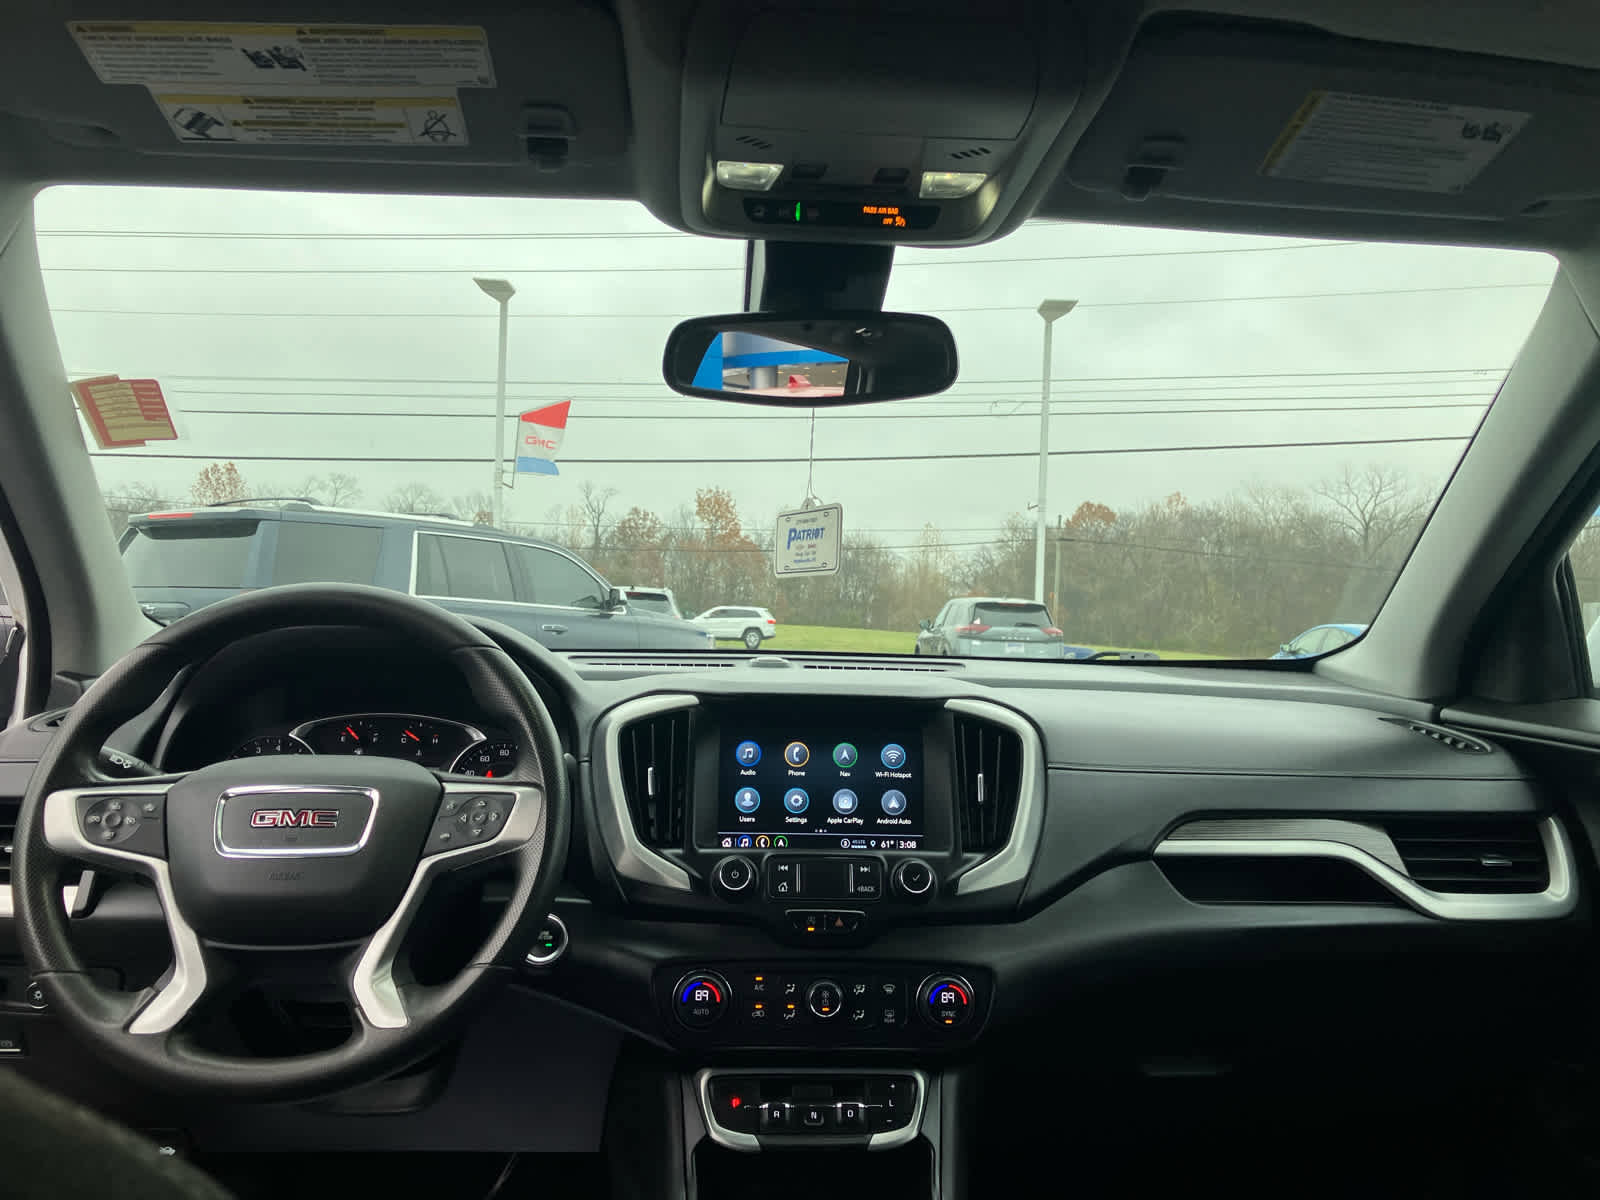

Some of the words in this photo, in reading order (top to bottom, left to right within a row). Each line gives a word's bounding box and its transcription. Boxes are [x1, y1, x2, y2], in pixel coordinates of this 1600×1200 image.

[525, 435, 557, 450] GMC
[786, 527, 825, 551] PATRIOT
[255, 746, 262, 754] 3
[889, 771, 912, 779] Hotspot
[250, 809, 338, 828] GMC
[739, 815, 756, 823] Users
[785, 816, 808, 825] Settings
[826, 817, 843, 825] Apple
[843, 817, 864, 826] CarPlay
[876, 817, 898, 825] Android
[881, 840, 894, 849] 61°
[899, 840, 917, 849] 3:08
[695, 989, 709, 1001] 89
[941, 991, 955, 1004] 89
[693, 1008, 710, 1016] AUTO
[888, 1099, 894, 1107] L
[810, 1111, 817, 1119] N
[847, 1110, 854, 1118] D
